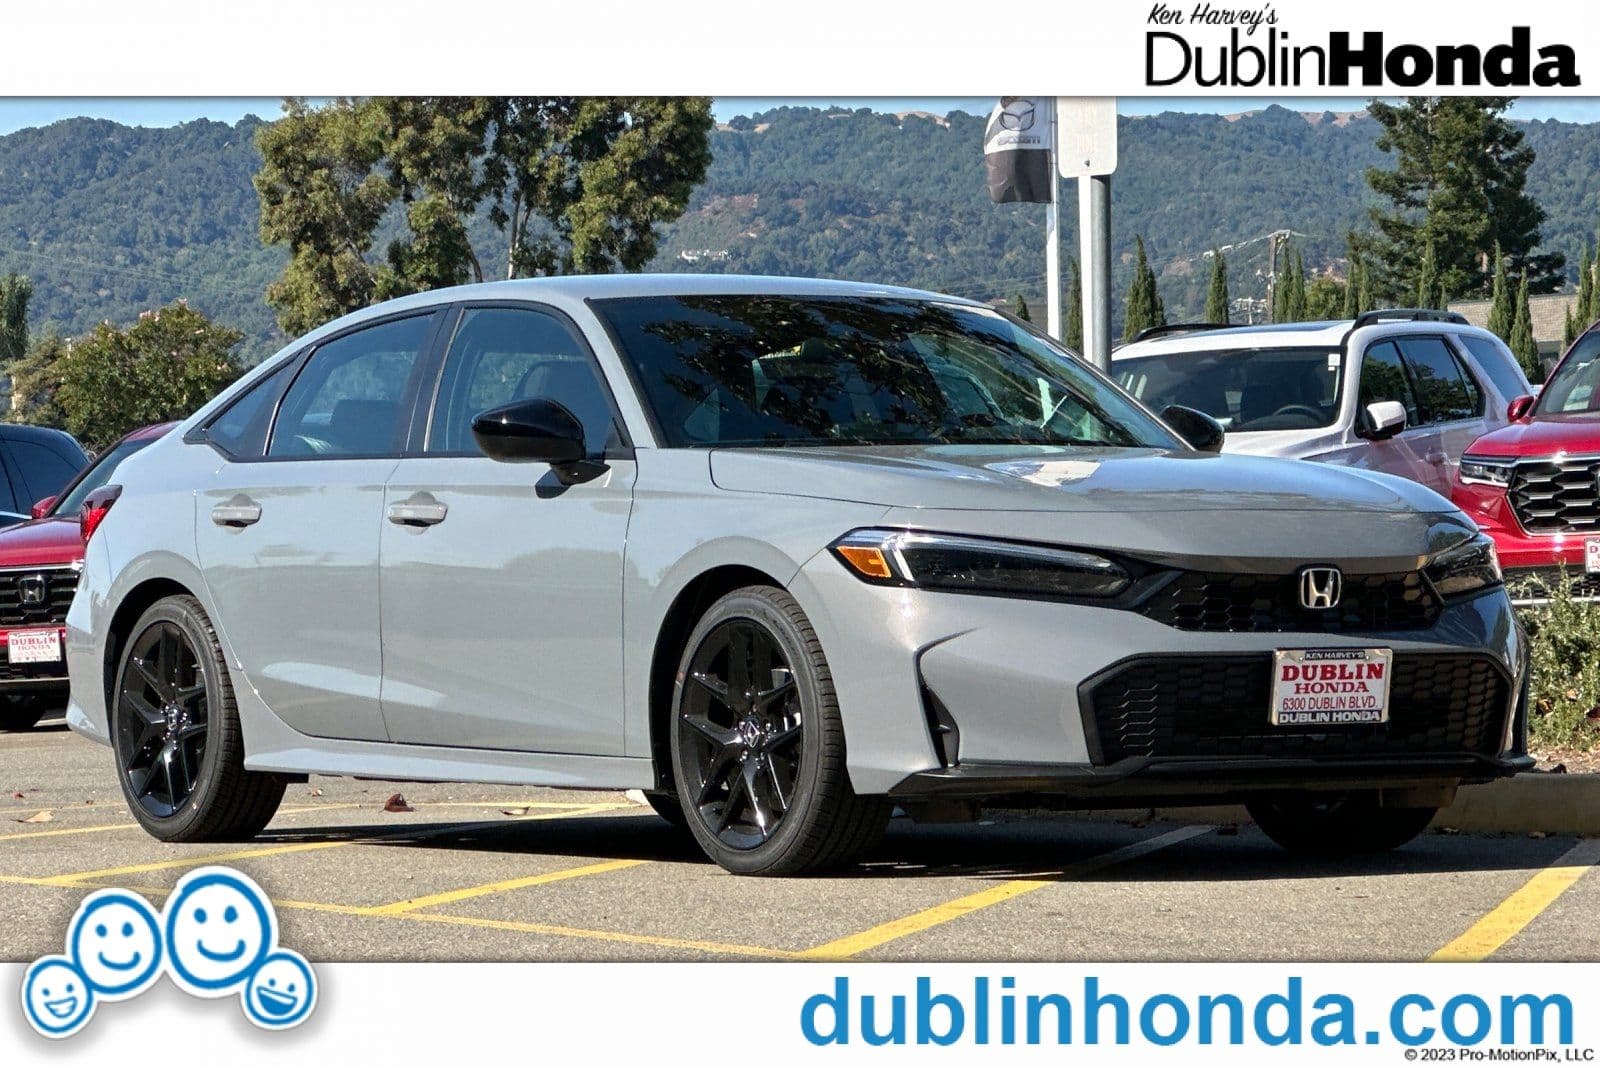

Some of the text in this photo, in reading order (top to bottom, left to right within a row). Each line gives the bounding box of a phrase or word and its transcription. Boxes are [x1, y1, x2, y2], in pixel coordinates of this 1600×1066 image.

[1281, 663, 1385, 681] DUBLIN
[1294, 681, 1369, 694] HONDA
[1282, 697, 1306, 711] 6300
[1308, 696, 1347, 710] DUBLIN
[1279, 711, 1380, 723] DUBLIN HONDA
